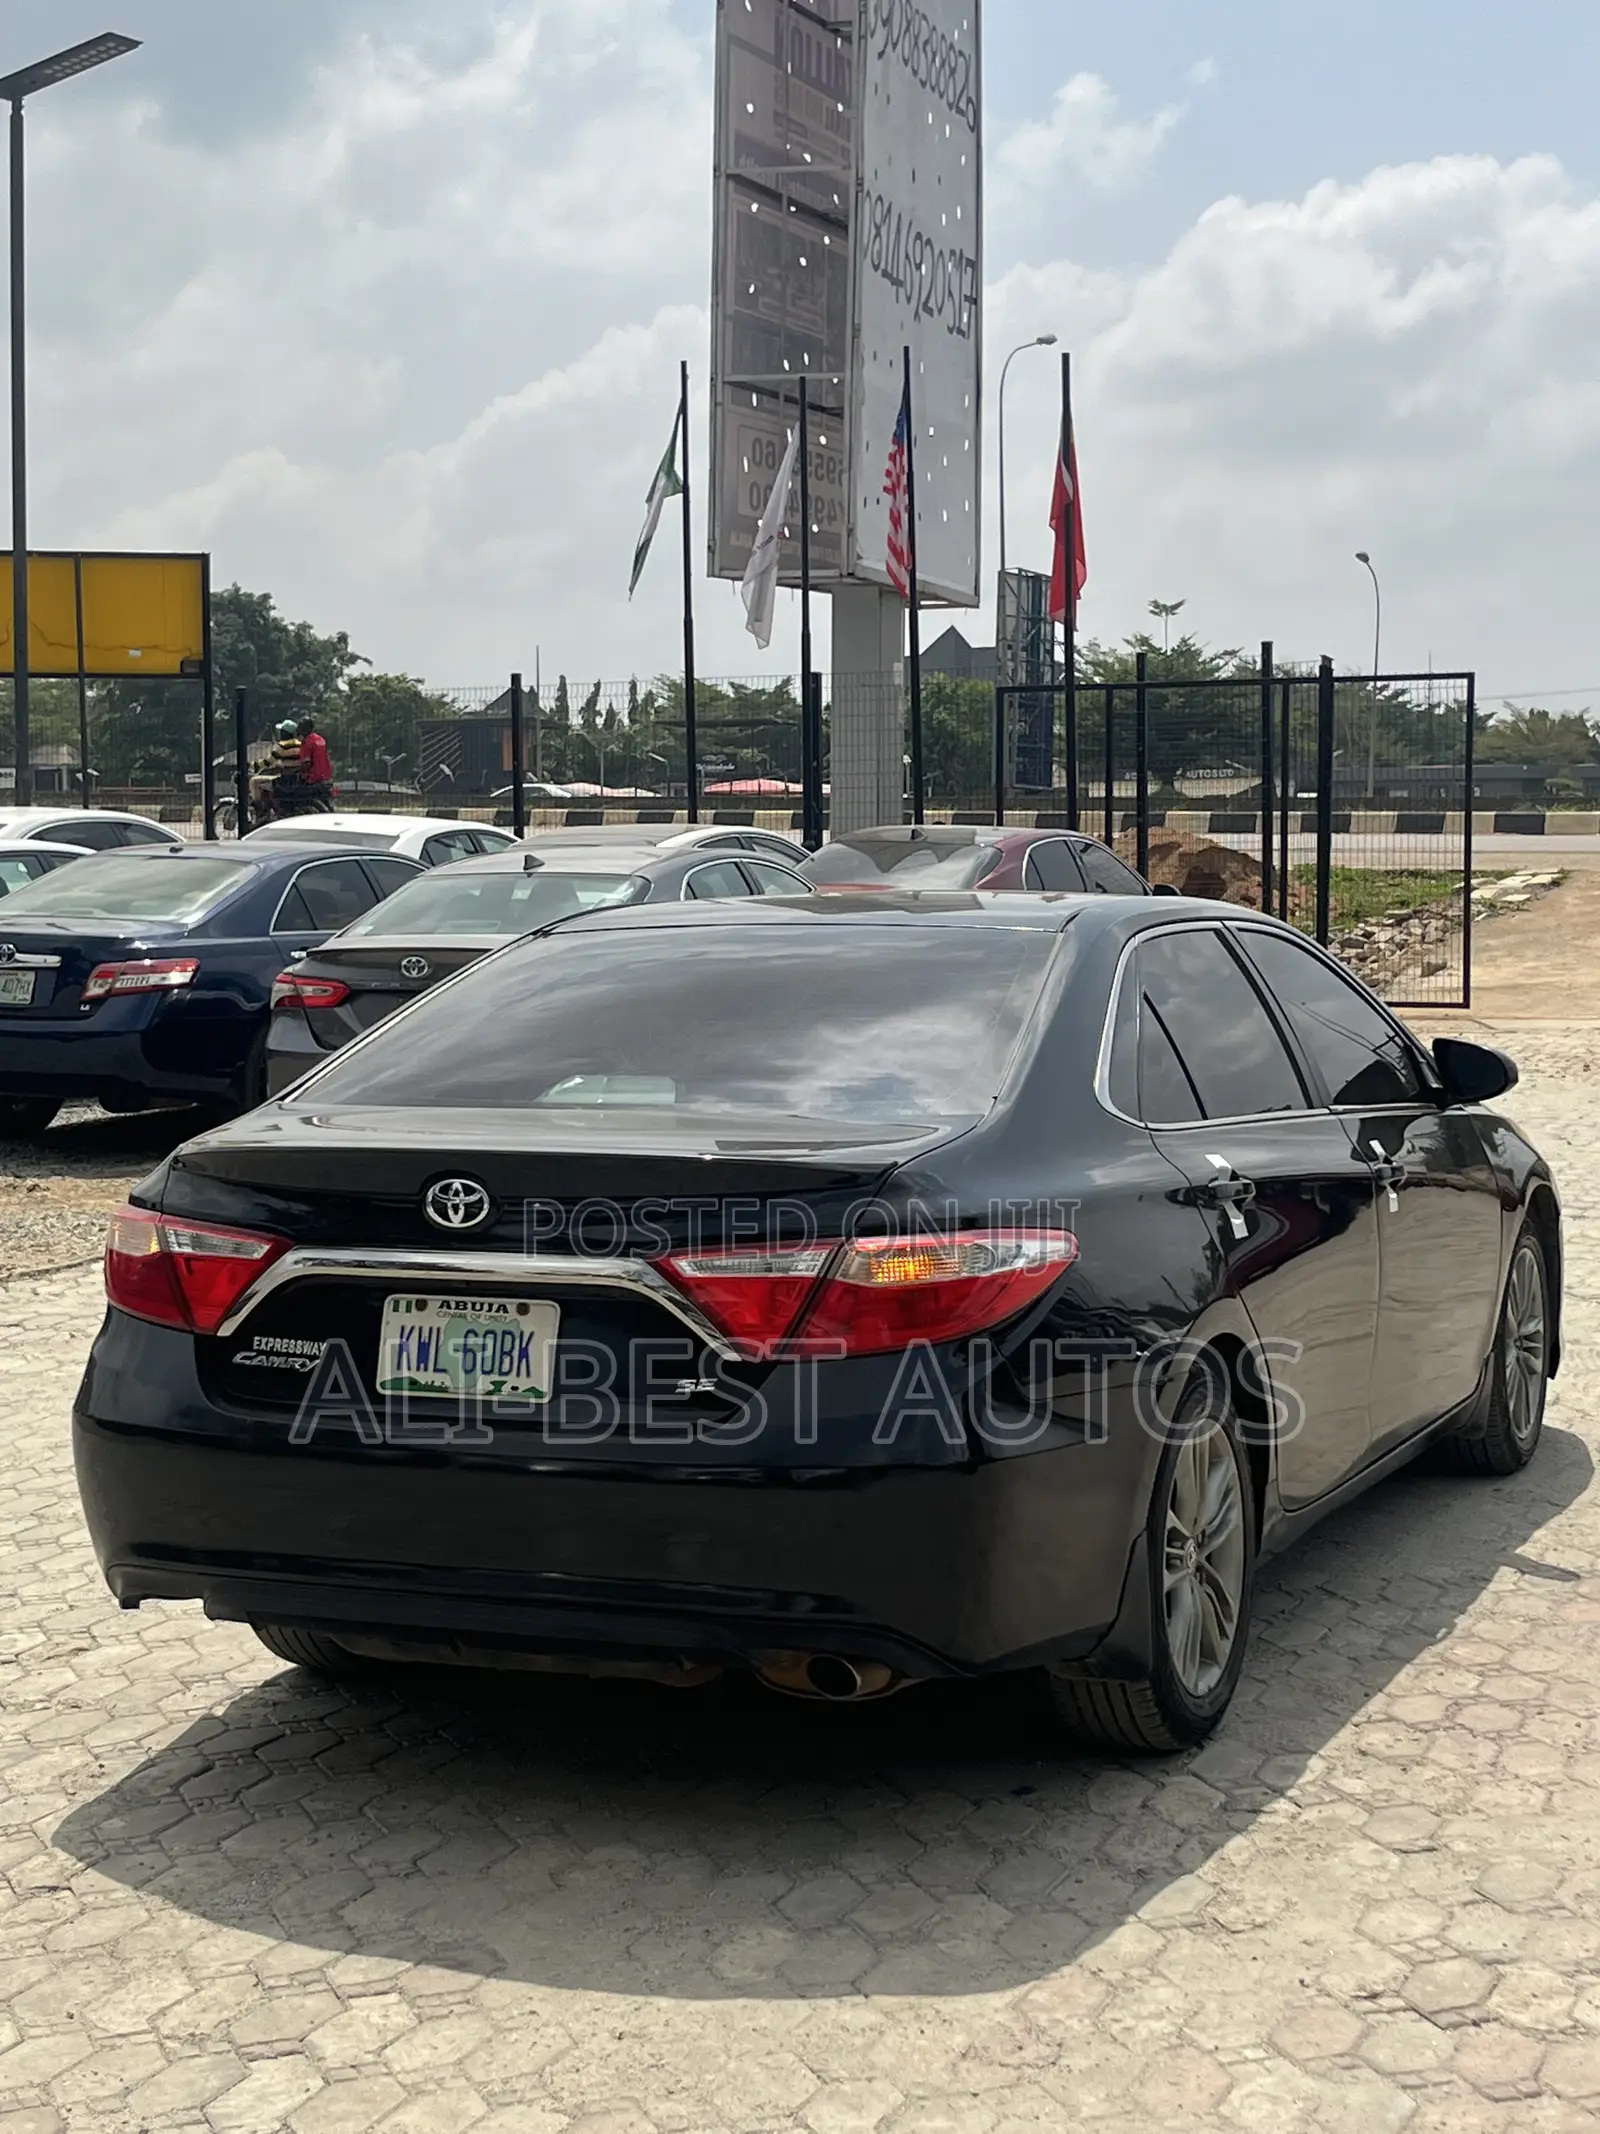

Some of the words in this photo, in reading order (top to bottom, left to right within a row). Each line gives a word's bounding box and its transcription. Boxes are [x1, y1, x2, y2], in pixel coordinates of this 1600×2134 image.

[438, 1299, 510, 1315] ABUJA
[253, 1335, 327, 1356] EXPRESSWAY
[397, 1324, 447, 1373] KWL
[232, 1351, 321, 1373] CAMRY
[675, 1378, 718, 1393] SE
